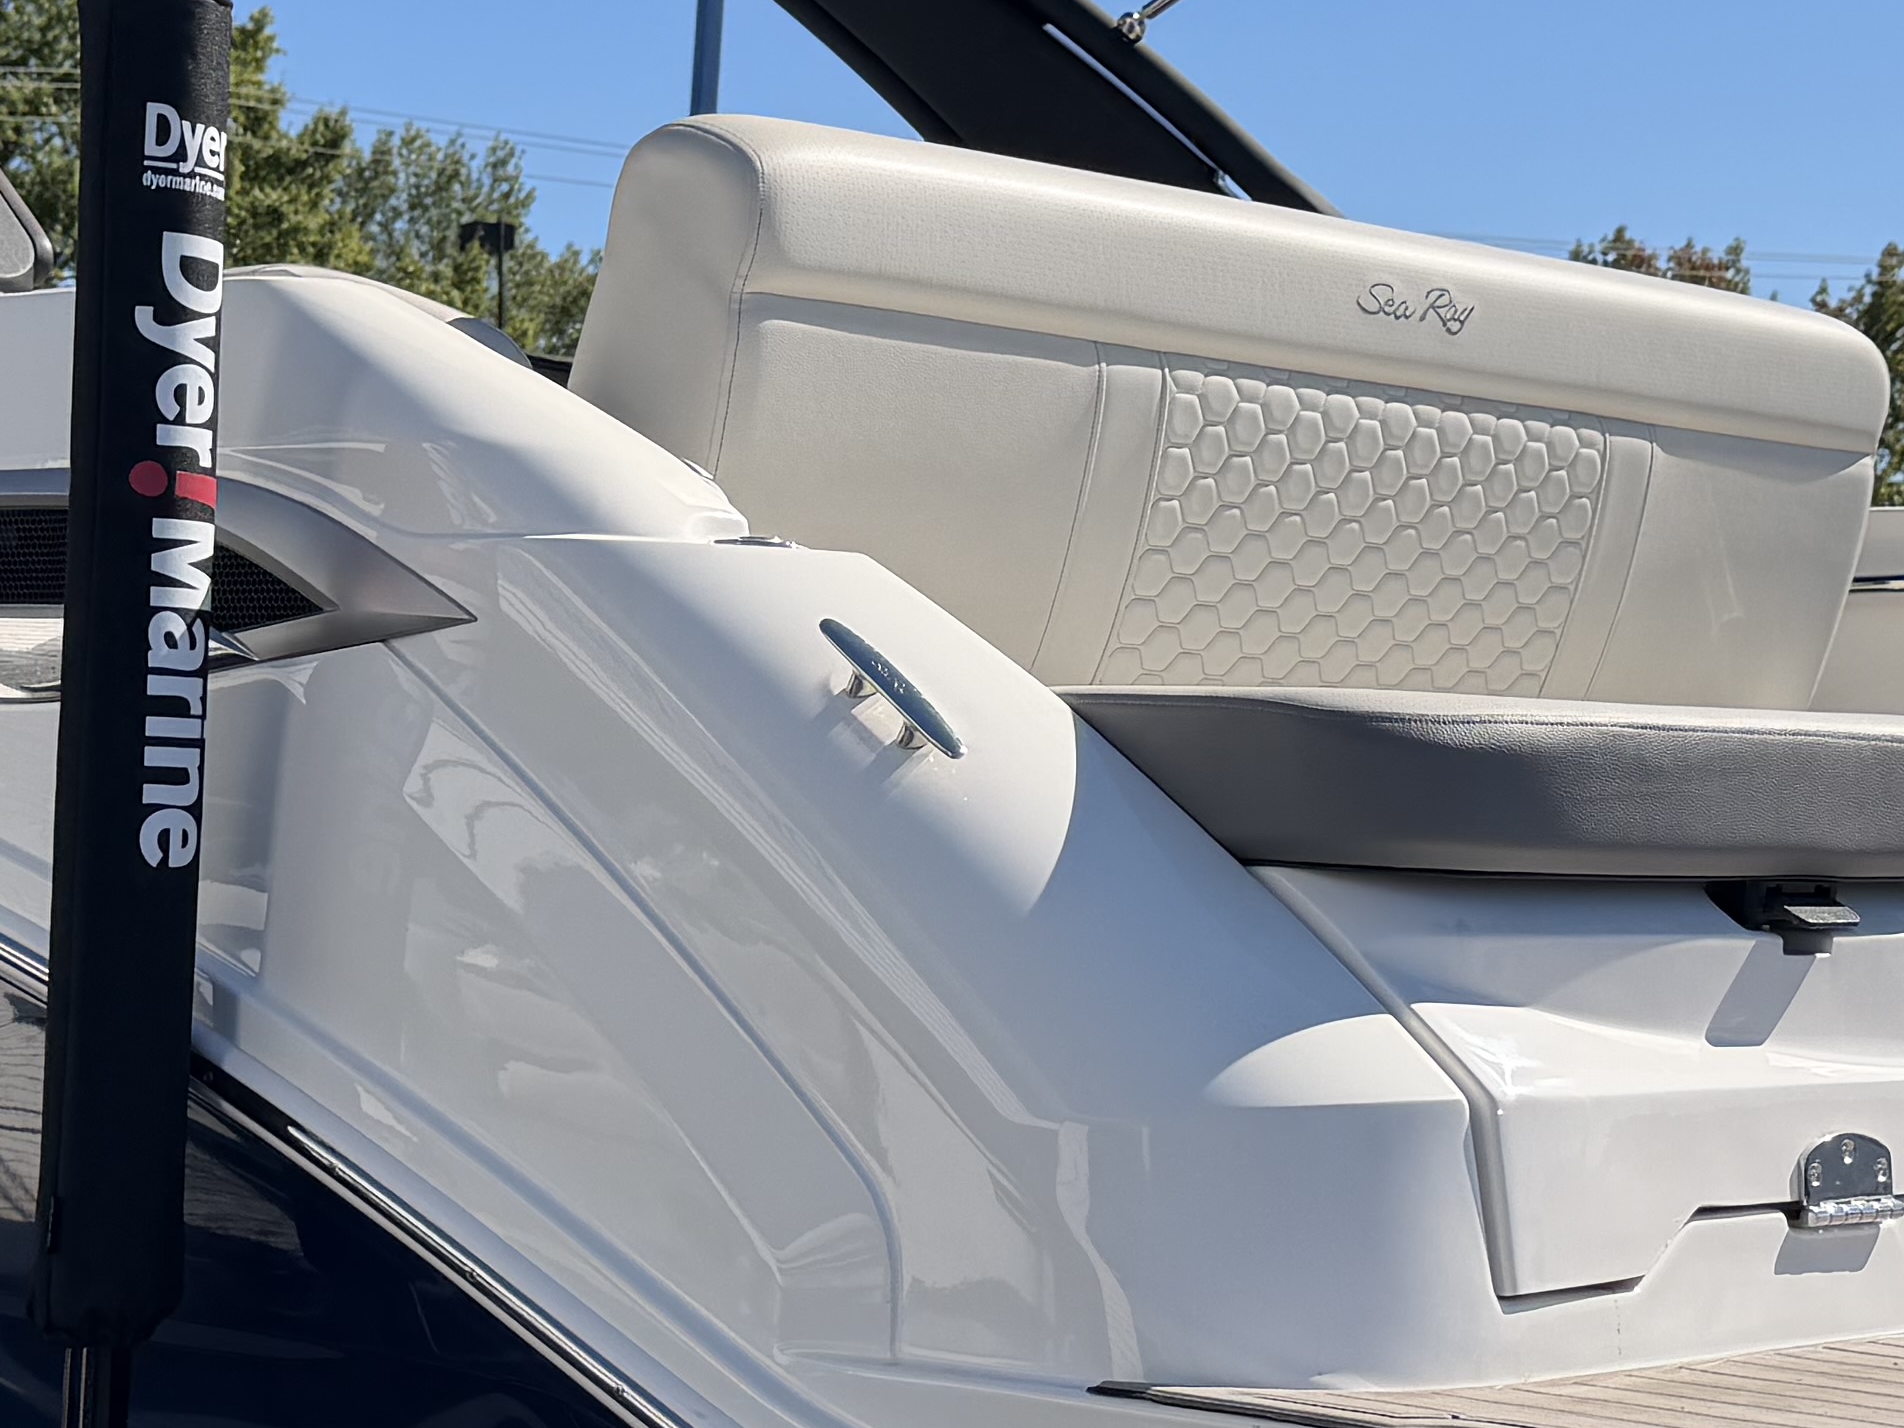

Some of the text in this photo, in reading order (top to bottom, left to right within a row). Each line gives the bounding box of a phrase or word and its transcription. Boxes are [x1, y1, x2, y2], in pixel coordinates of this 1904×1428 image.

[144, 101, 228, 174] Dyer
[1356, 283, 1475, 336] Sea Ray
[119, 517, 216, 868] Marine
